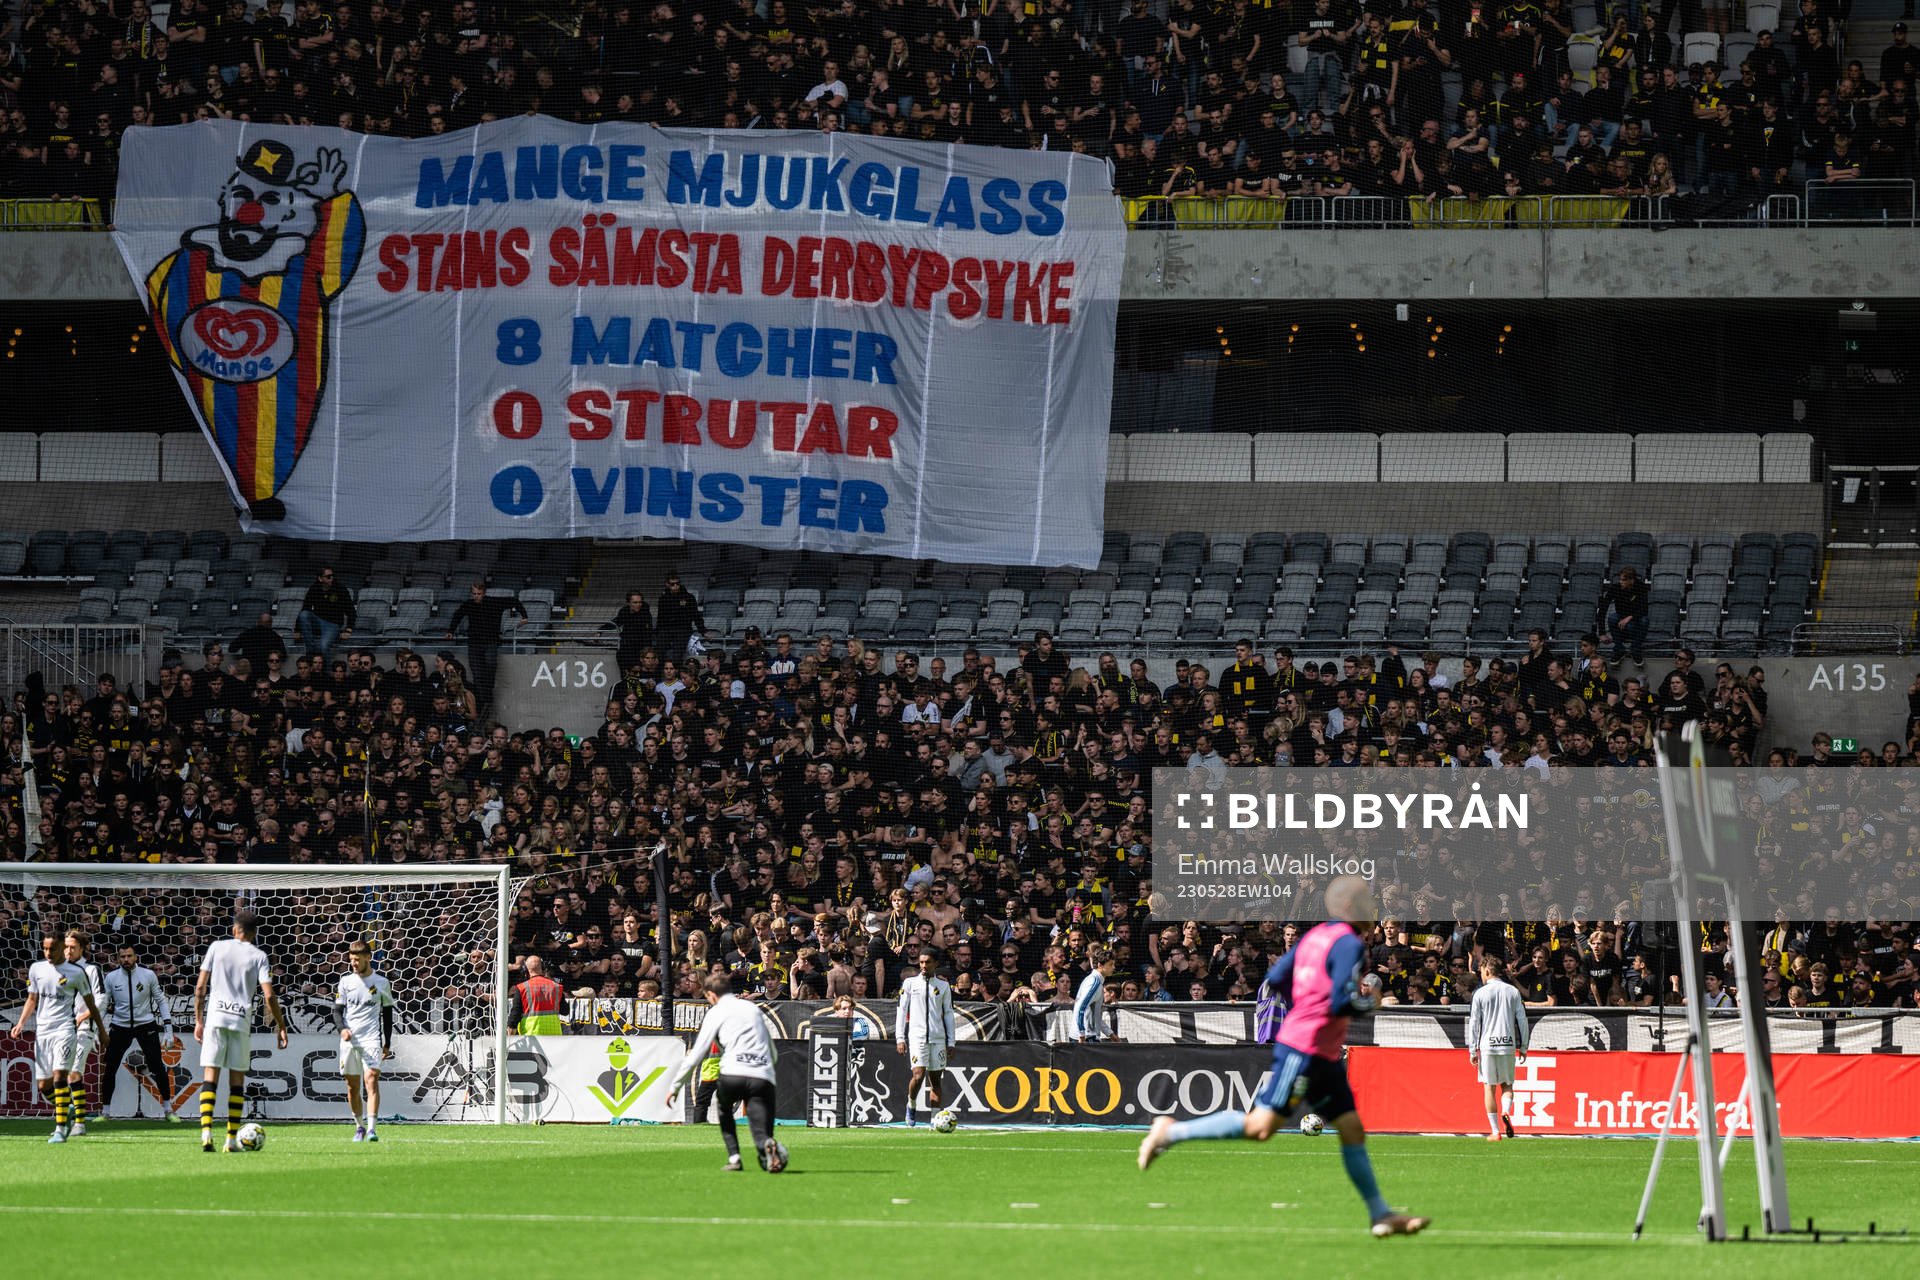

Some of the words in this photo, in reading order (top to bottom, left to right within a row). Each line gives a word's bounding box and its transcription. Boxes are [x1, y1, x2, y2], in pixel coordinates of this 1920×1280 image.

[416, 145, 647, 208] MANGE
[667, 150, 1068, 236] MJUKGLASS
[377, 227, 531, 293] STANS
[549, 213, 742, 294] SÄMSTA
[762, 235, 1074, 325] DERBYPSYKE
[195, 349, 274, 379] Mange
[496, 318, 542, 366] 8
[570, 316, 898, 385] MATCHER
[567, 390, 899, 459] STRUTAR
[571, 466, 888, 534] VINSTER
[531, 660, 607, 688] A136
[1808, 663, 1886, 691] A135
[812, 1034, 838, 1128] SELECT
[1574, 1091, 1781, 1129] Infrakra
